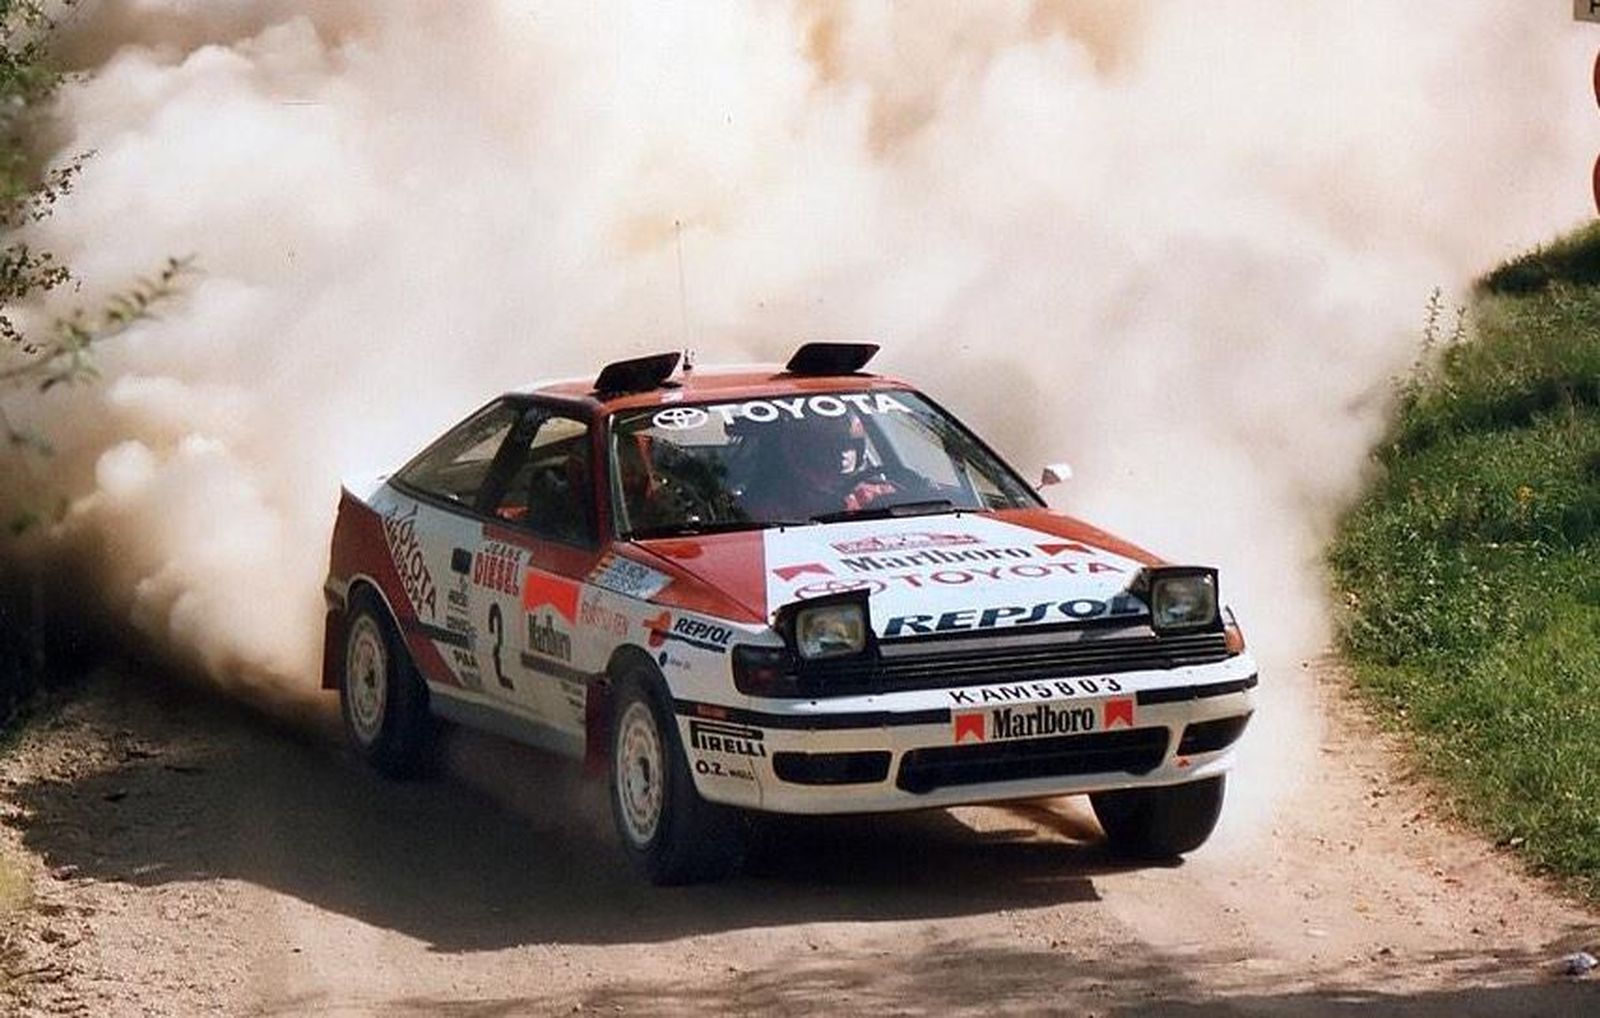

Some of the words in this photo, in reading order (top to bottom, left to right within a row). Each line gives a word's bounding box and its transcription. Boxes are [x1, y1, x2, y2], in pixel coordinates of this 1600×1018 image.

[708, 394, 912, 425] TOYOTA
[841, 545, 1033, 574] Marlboro
[891, 562, 1125, 588] TOYOTA
[674, 617, 733, 645] REPSOL
[883, 596, 1140, 637] REPSOL
[488, 603, 515, 691] 2
[689, 719, 767, 758] PIRELLI
[991, 704, 1095, 740] Marlboro
